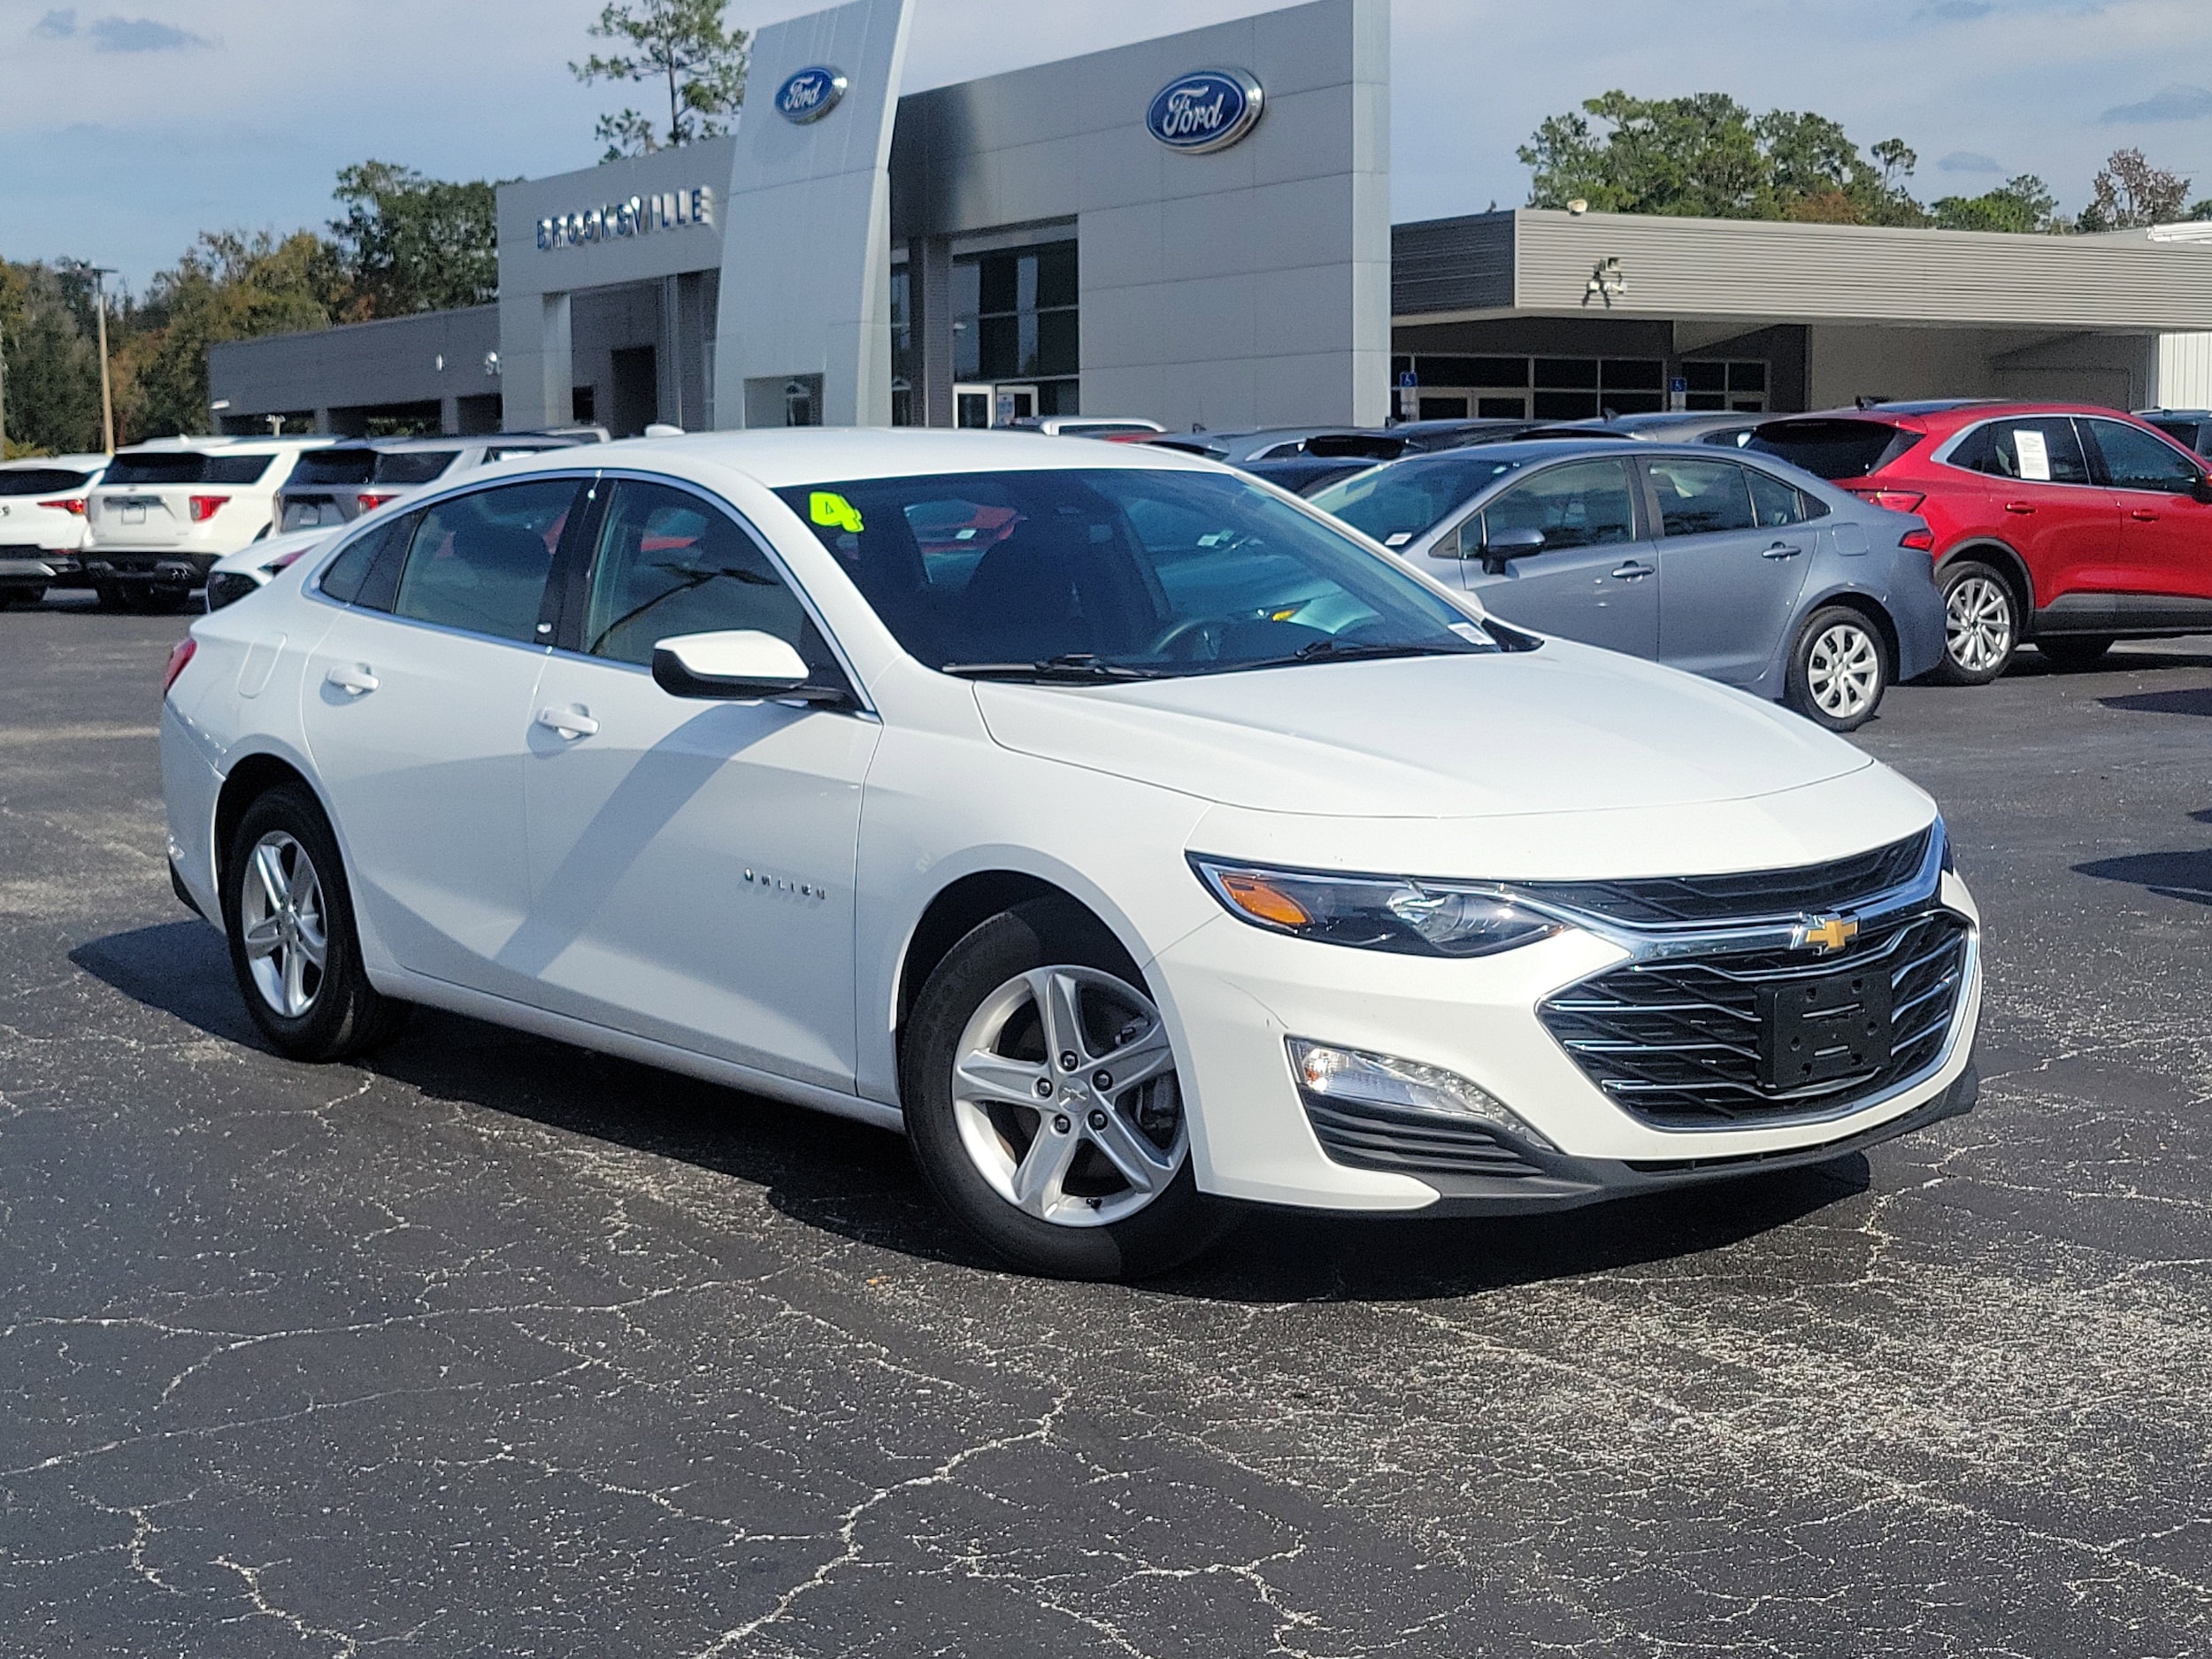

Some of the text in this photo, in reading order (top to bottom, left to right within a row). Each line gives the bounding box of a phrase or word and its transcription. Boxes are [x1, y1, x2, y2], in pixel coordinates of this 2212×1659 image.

[784, 76, 823, 111] Ford
[1163, 85, 1225, 136] Ford
[537, 186, 710, 250] BROOKSVILLE
